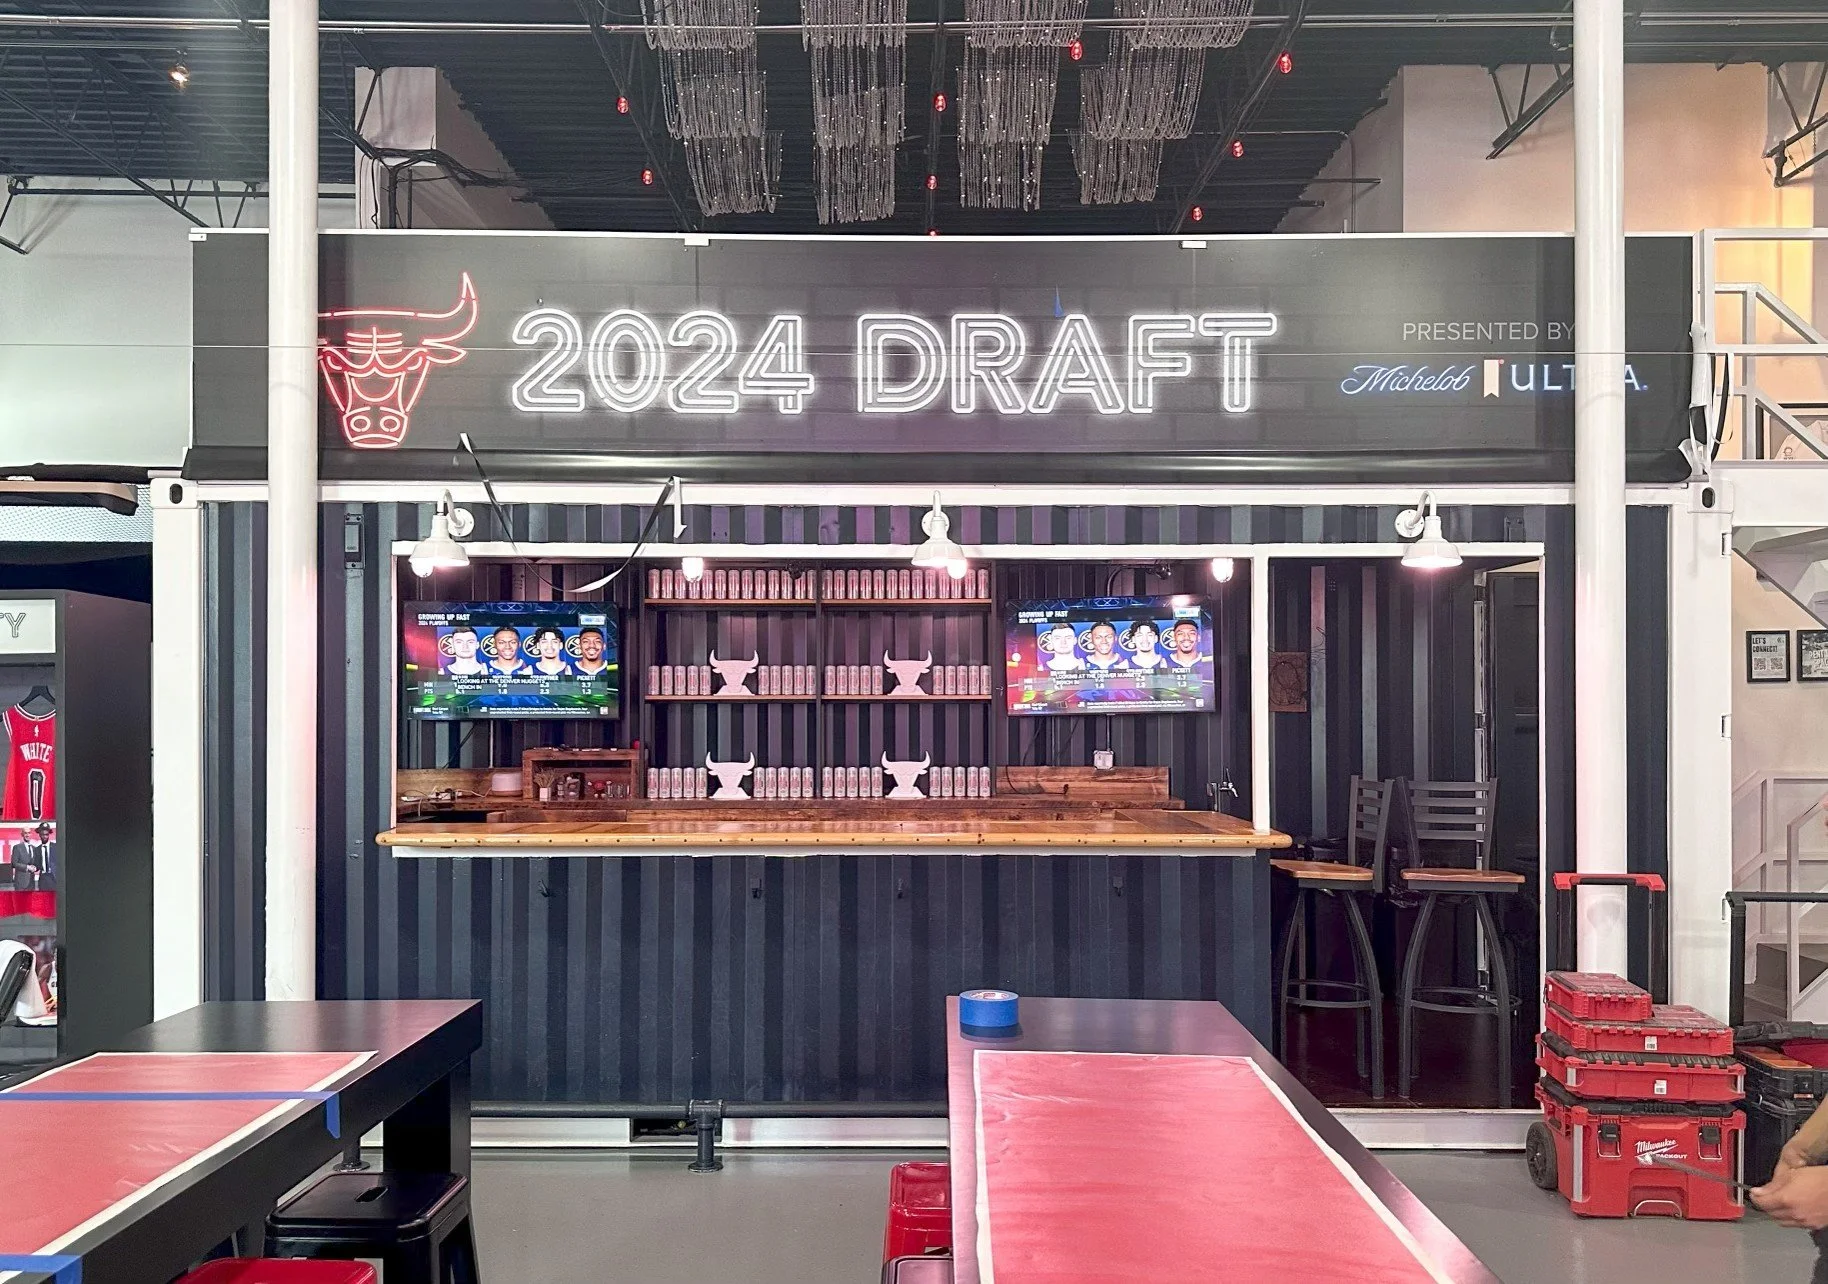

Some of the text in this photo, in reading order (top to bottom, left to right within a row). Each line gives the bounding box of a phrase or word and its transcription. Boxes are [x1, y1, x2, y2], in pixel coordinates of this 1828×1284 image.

[1402, 322, 1576, 341] PRESENTED BY
[512, 308, 1278, 414] 2024 DRAFT
[1340, 364, 1477, 395] Michelob
[0, 612, 27, 638] Y
[446, 613, 455, 621] UP
[456, 613, 470, 621] FAST
[20, 742, 53, 763] WHITE
[28, 767, 46, 820] 0
[1634, 1138, 1677, 1154] Milwaukee
